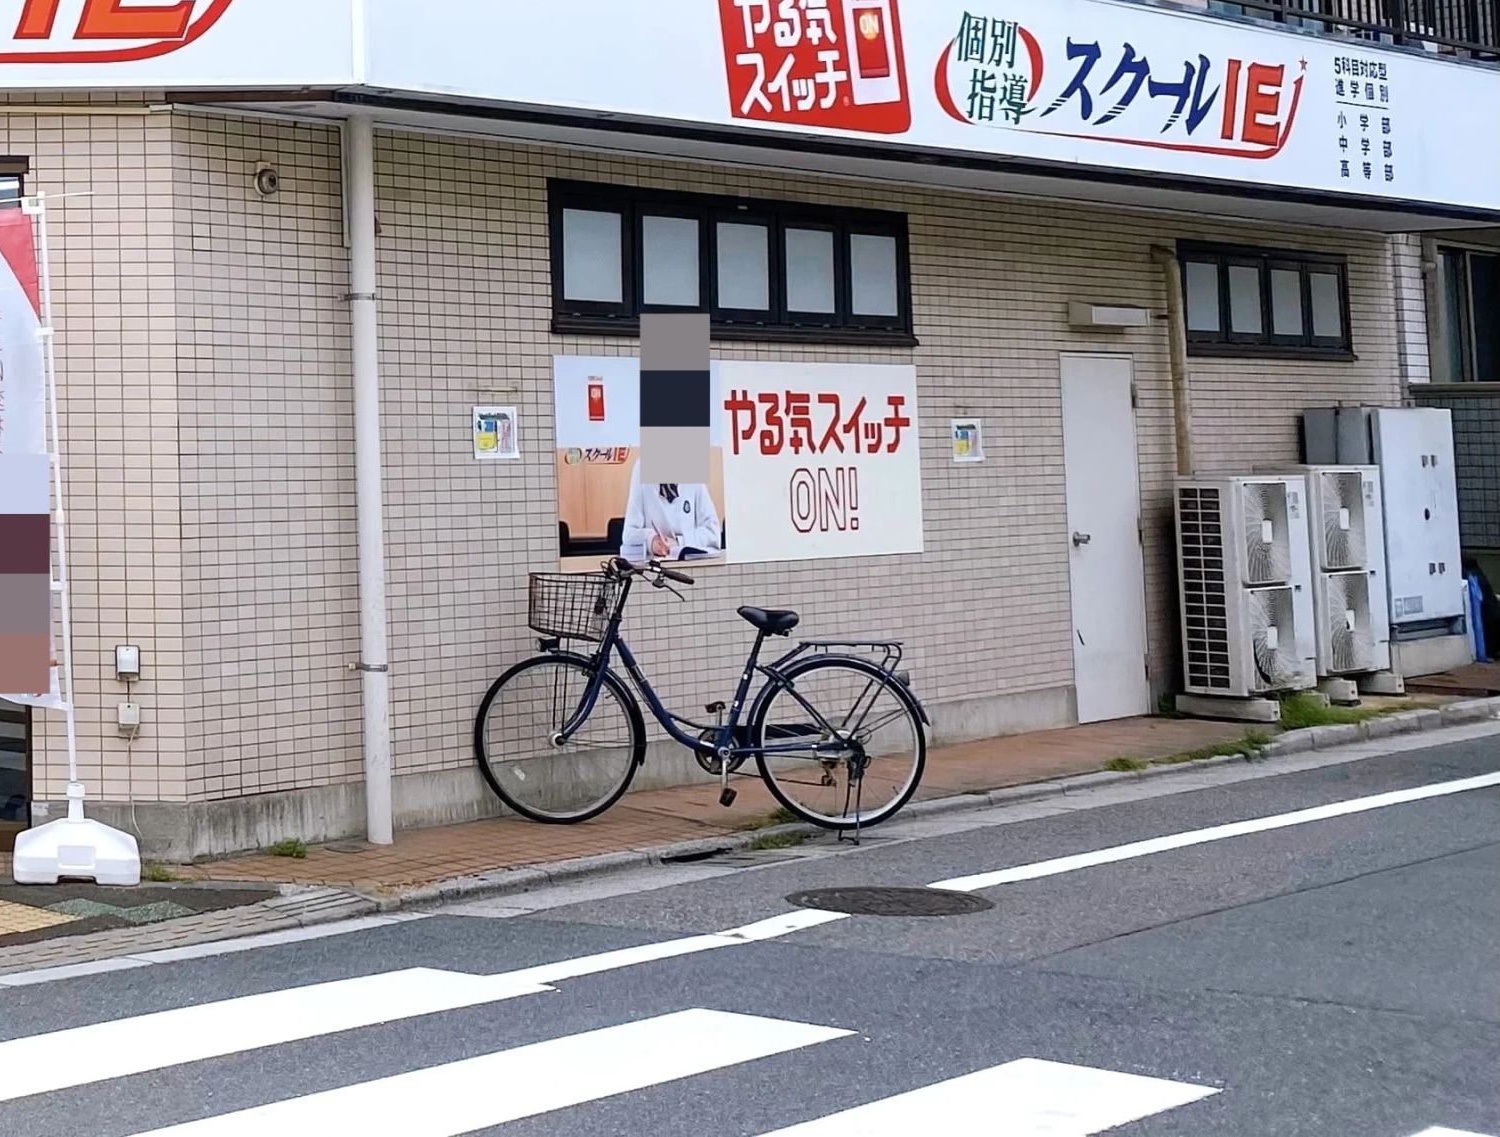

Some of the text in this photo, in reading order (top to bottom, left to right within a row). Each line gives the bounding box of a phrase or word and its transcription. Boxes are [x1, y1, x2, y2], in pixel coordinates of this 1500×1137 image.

[955, 10, 1018, 69] 個別
[736, 50, 848, 116] スイッチ
[967, 68, 1036, 126] 指導
[1040, 36, 1285, 147] スクールIE
[724, 389, 910, 455] やる気スイッチ
[790, 466, 859, 533] ON!
